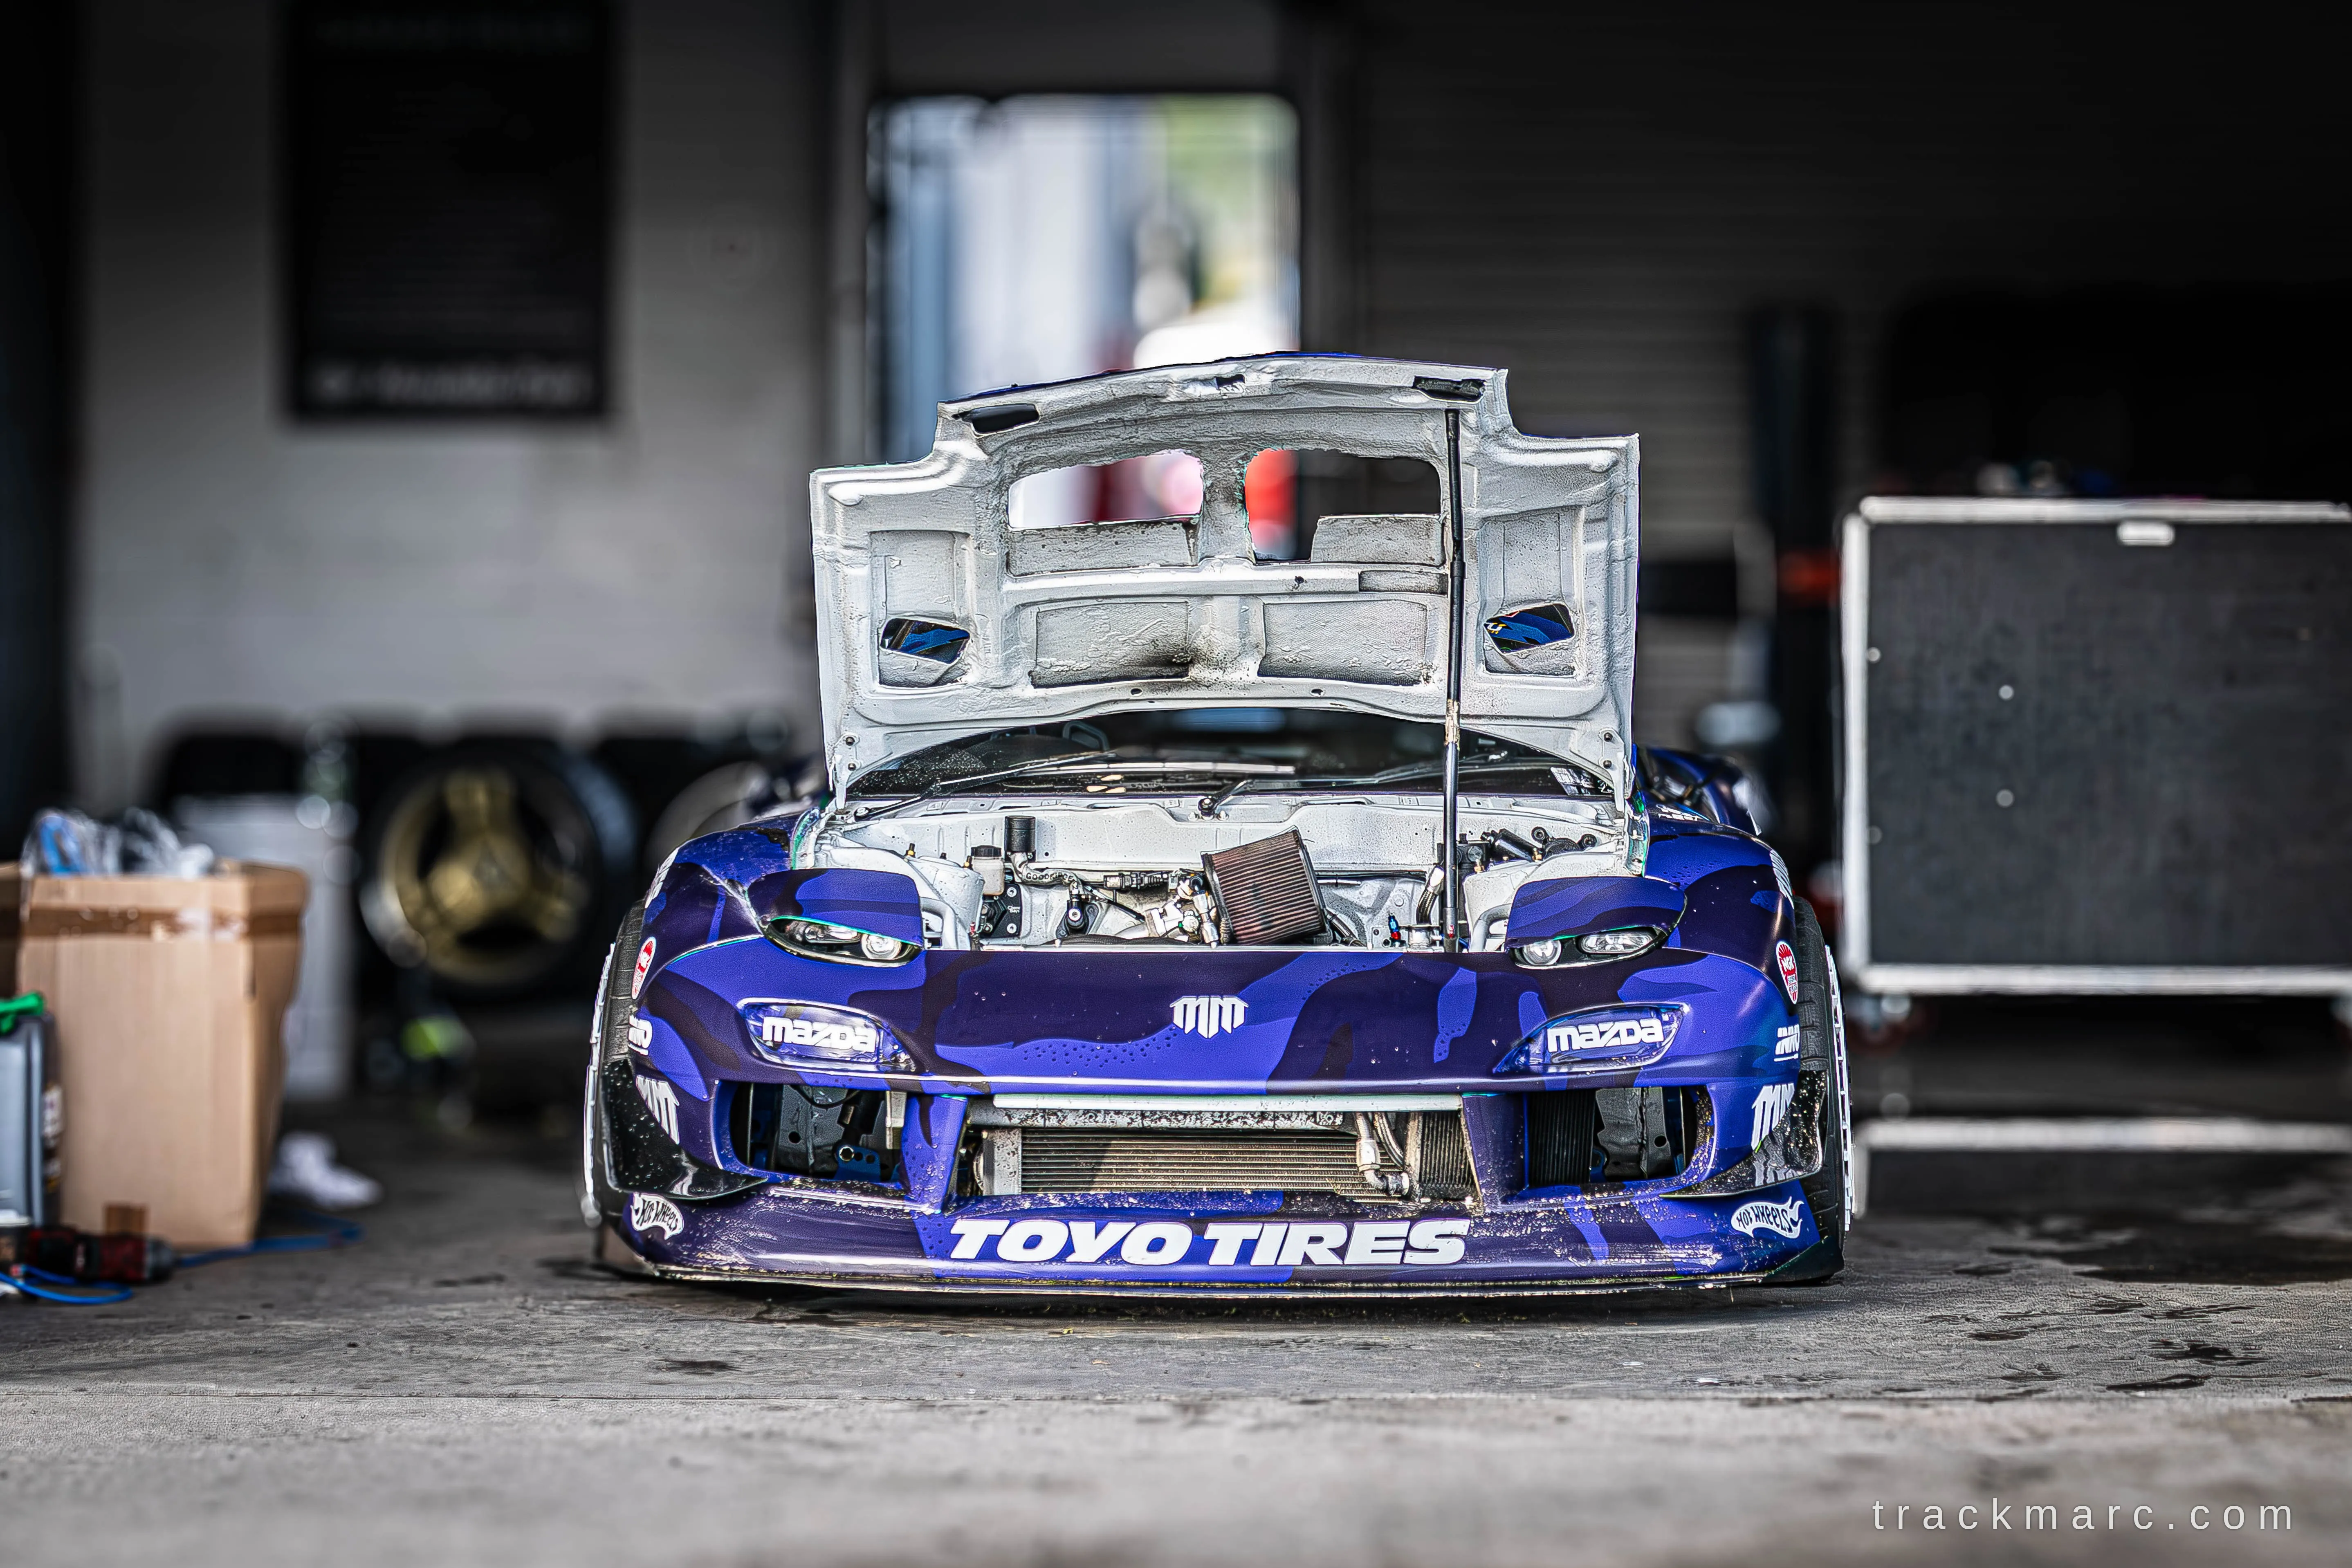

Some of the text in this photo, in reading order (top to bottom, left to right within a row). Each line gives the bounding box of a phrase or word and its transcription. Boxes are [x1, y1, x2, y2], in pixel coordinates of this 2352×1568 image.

[1781, 956, 1795, 972] NGK
[1547, 1018, 1664, 1053] mazda
[949, 1219, 1470, 1266] TOYO TIRES
